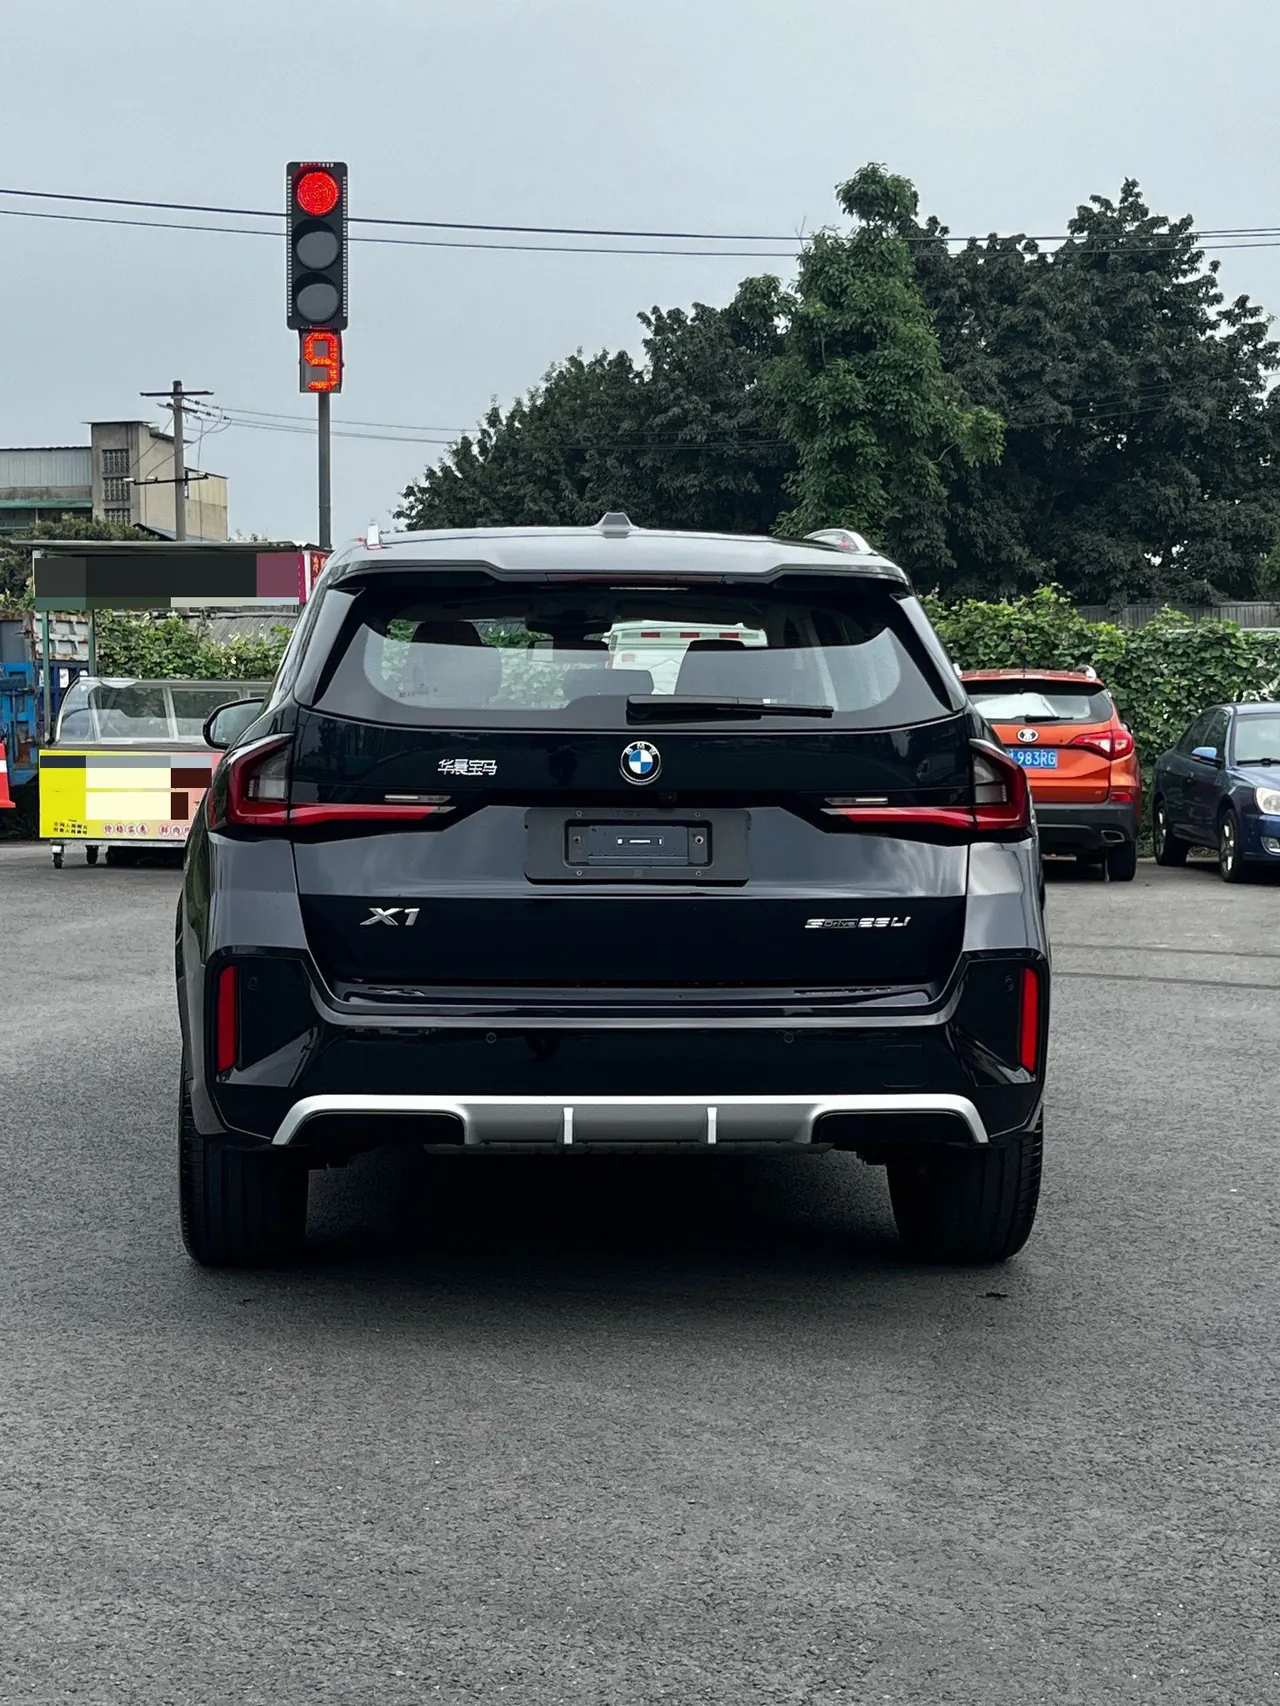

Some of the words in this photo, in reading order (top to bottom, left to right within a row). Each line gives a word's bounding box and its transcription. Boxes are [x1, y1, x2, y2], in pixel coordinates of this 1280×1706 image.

[304, 332, 338, 391] 9
[625, 742, 658, 756] BMW
[437, 758, 498, 776] 华晨宝马
[359, 907, 421, 926] X1
